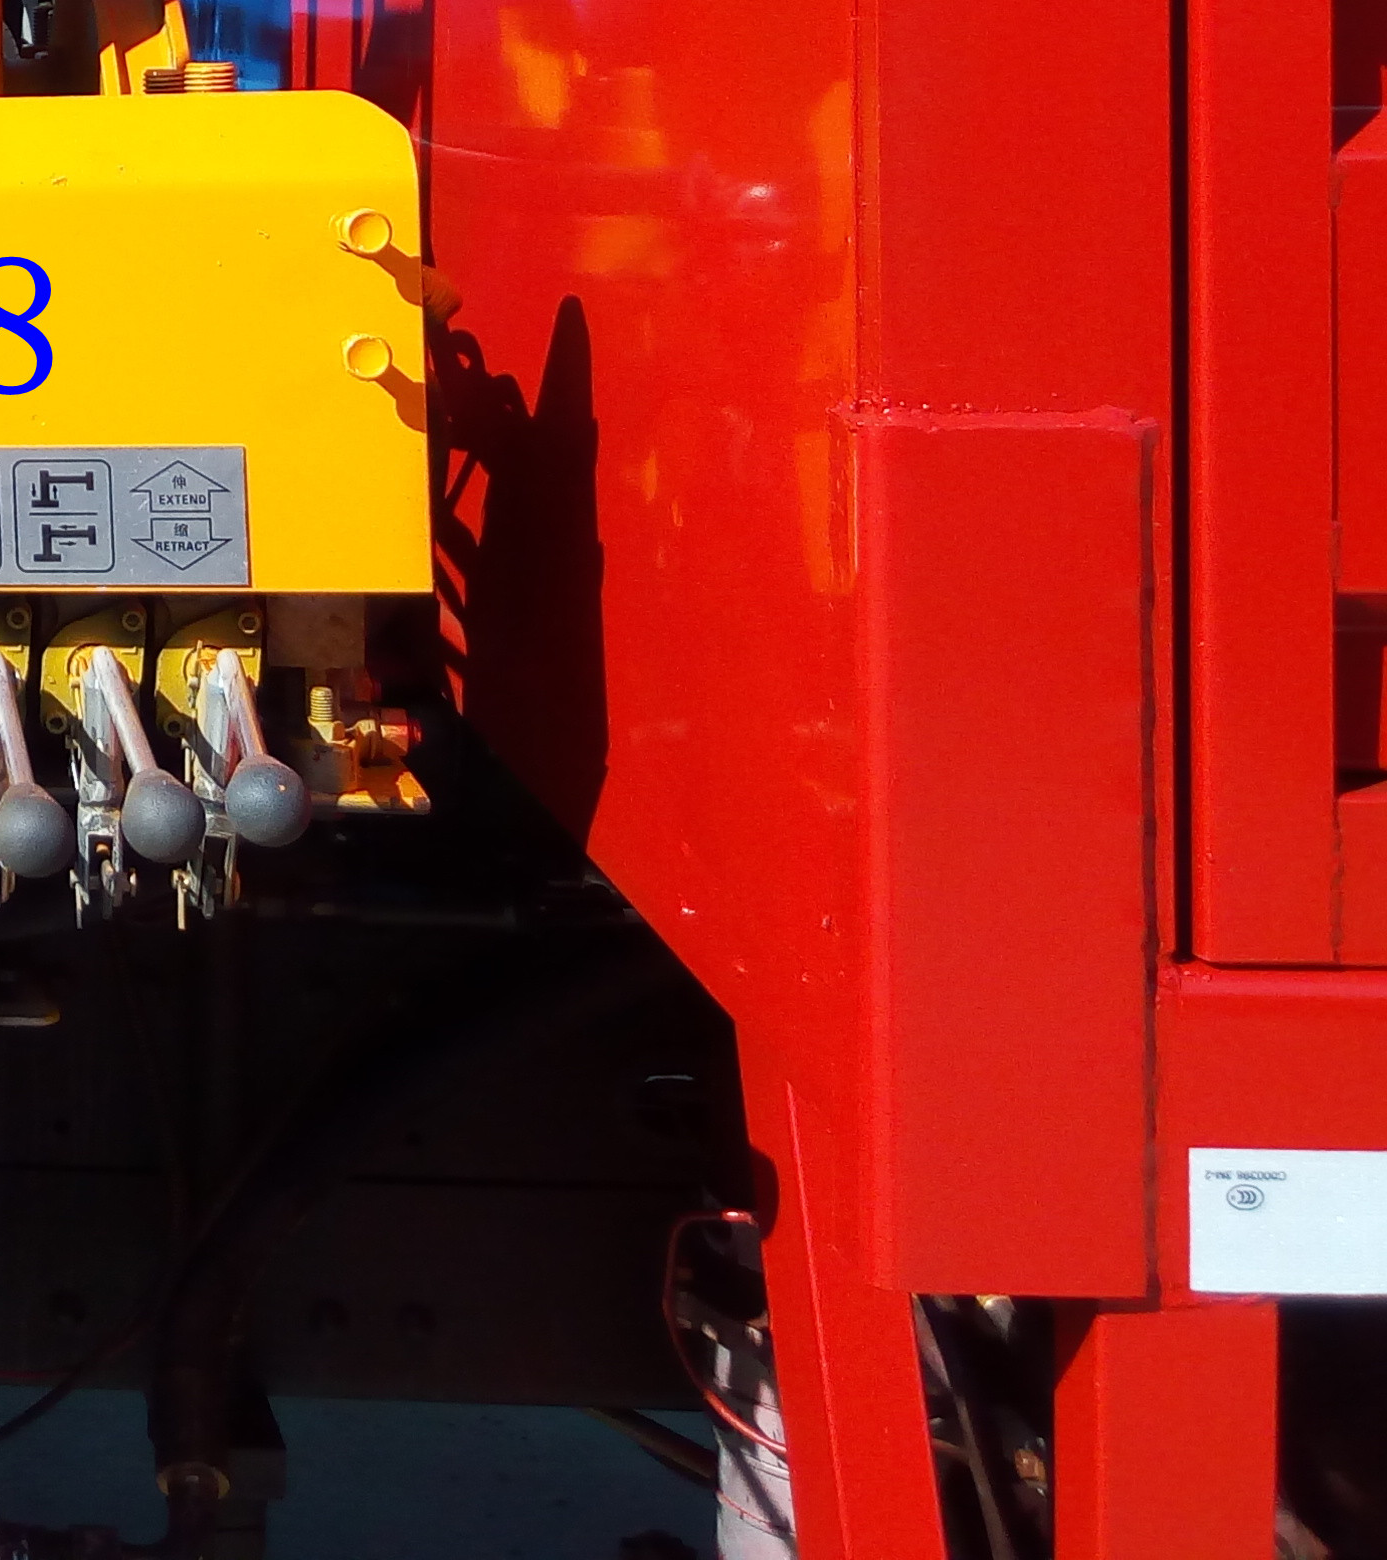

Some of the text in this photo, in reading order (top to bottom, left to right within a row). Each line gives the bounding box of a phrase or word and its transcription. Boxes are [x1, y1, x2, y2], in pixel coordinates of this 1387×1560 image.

[172, 474, 187, 491] 伸
[159, 493, 207, 506] EXTEND
[173, 522, 189, 538] 缩
[155, 540, 211, 553] RETRACT
